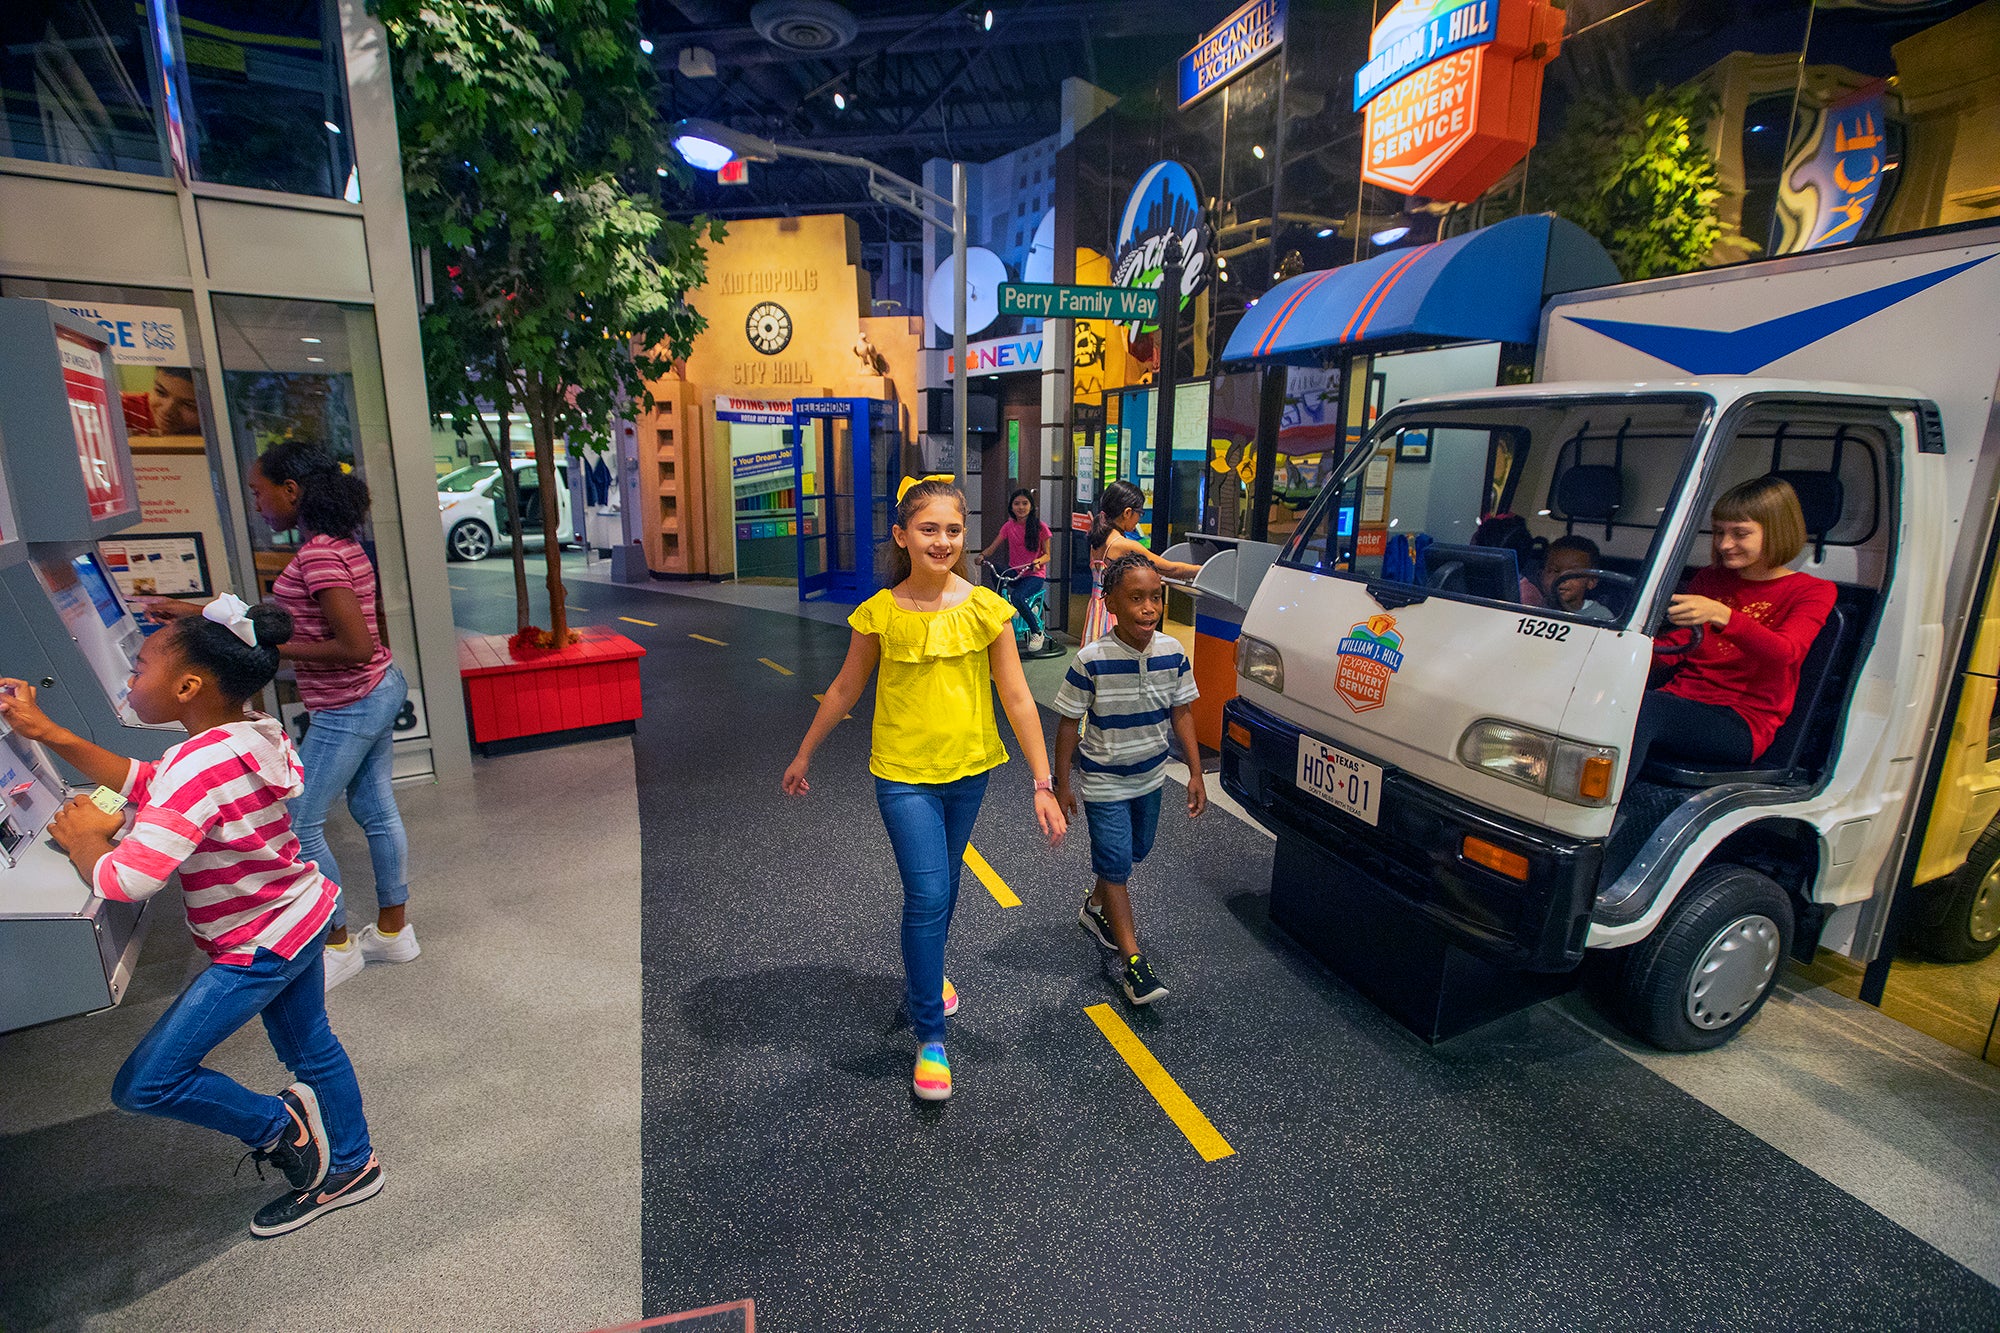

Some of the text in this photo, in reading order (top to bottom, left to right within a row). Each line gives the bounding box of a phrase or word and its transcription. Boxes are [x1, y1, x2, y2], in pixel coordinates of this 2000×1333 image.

[1193, 0, 1277, 71] MERCANTILE
[1359, 1, 1489, 97] WILLIAM J. HILL
[1198, 21, 1273, 90] EXCHANGE
[1375, 51, 1472, 118] EXPRESS
[1373, 79, 1468, 141] DELIVERY
[1372, 107, 1464, 165] SERVICE
[1144, 227, 1174, 271] Cit
[720, 269, 818, 295] KIDTROPOLIS
[1005, 287, 1157, 318] Perry Family Way
[733, 360, 813, 385] CITY HALL
[729, 398, 793, 413] VOTING TODA
[797, 403, 850, 413] TELEPHONE
[738, 456, 754, 465] Your
[756, 453, 777, 462] Dream
[1517, 618, 1571, 642] 15292
[1341, 639, 1400, 668] WILLIAM J. HILL
[1343, 655, 1388, 678] EXPRESS
[1340, 678, 1380, 700] SERVICE
[1341, 667, 1384, 688] DELIVERY
[1335, 754, 1359, 772] TEXAS
[1303, 753, 1369, 811] HDS 01
